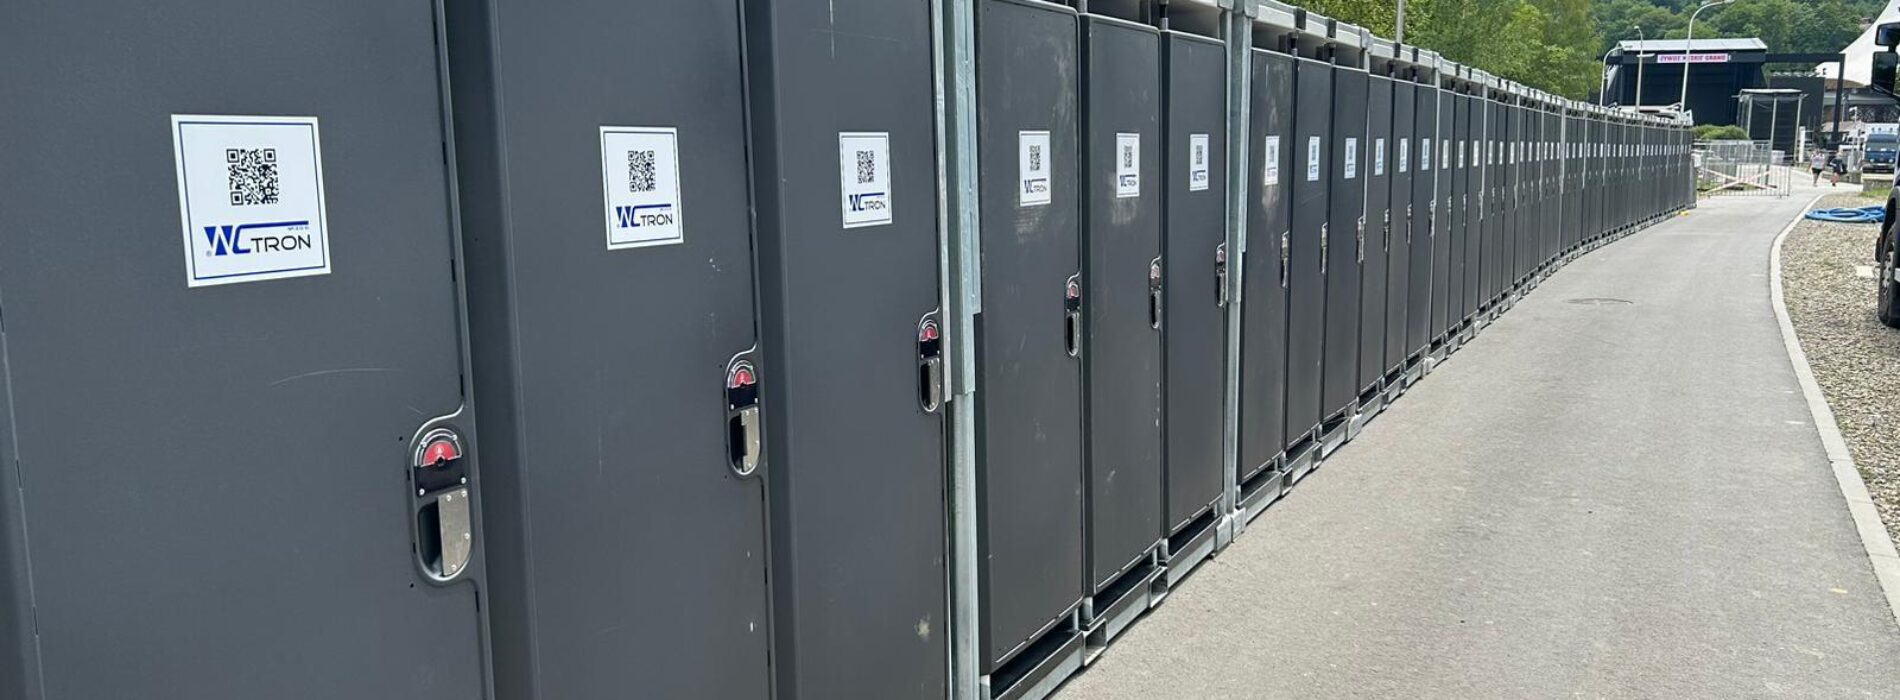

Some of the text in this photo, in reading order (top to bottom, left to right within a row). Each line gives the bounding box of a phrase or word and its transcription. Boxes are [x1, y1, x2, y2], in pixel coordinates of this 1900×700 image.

[848, 192, 886, 211] WCTRON
[615, 203, 673, 228] WCTRON
[203, 220, 311, 256] WCTRON
